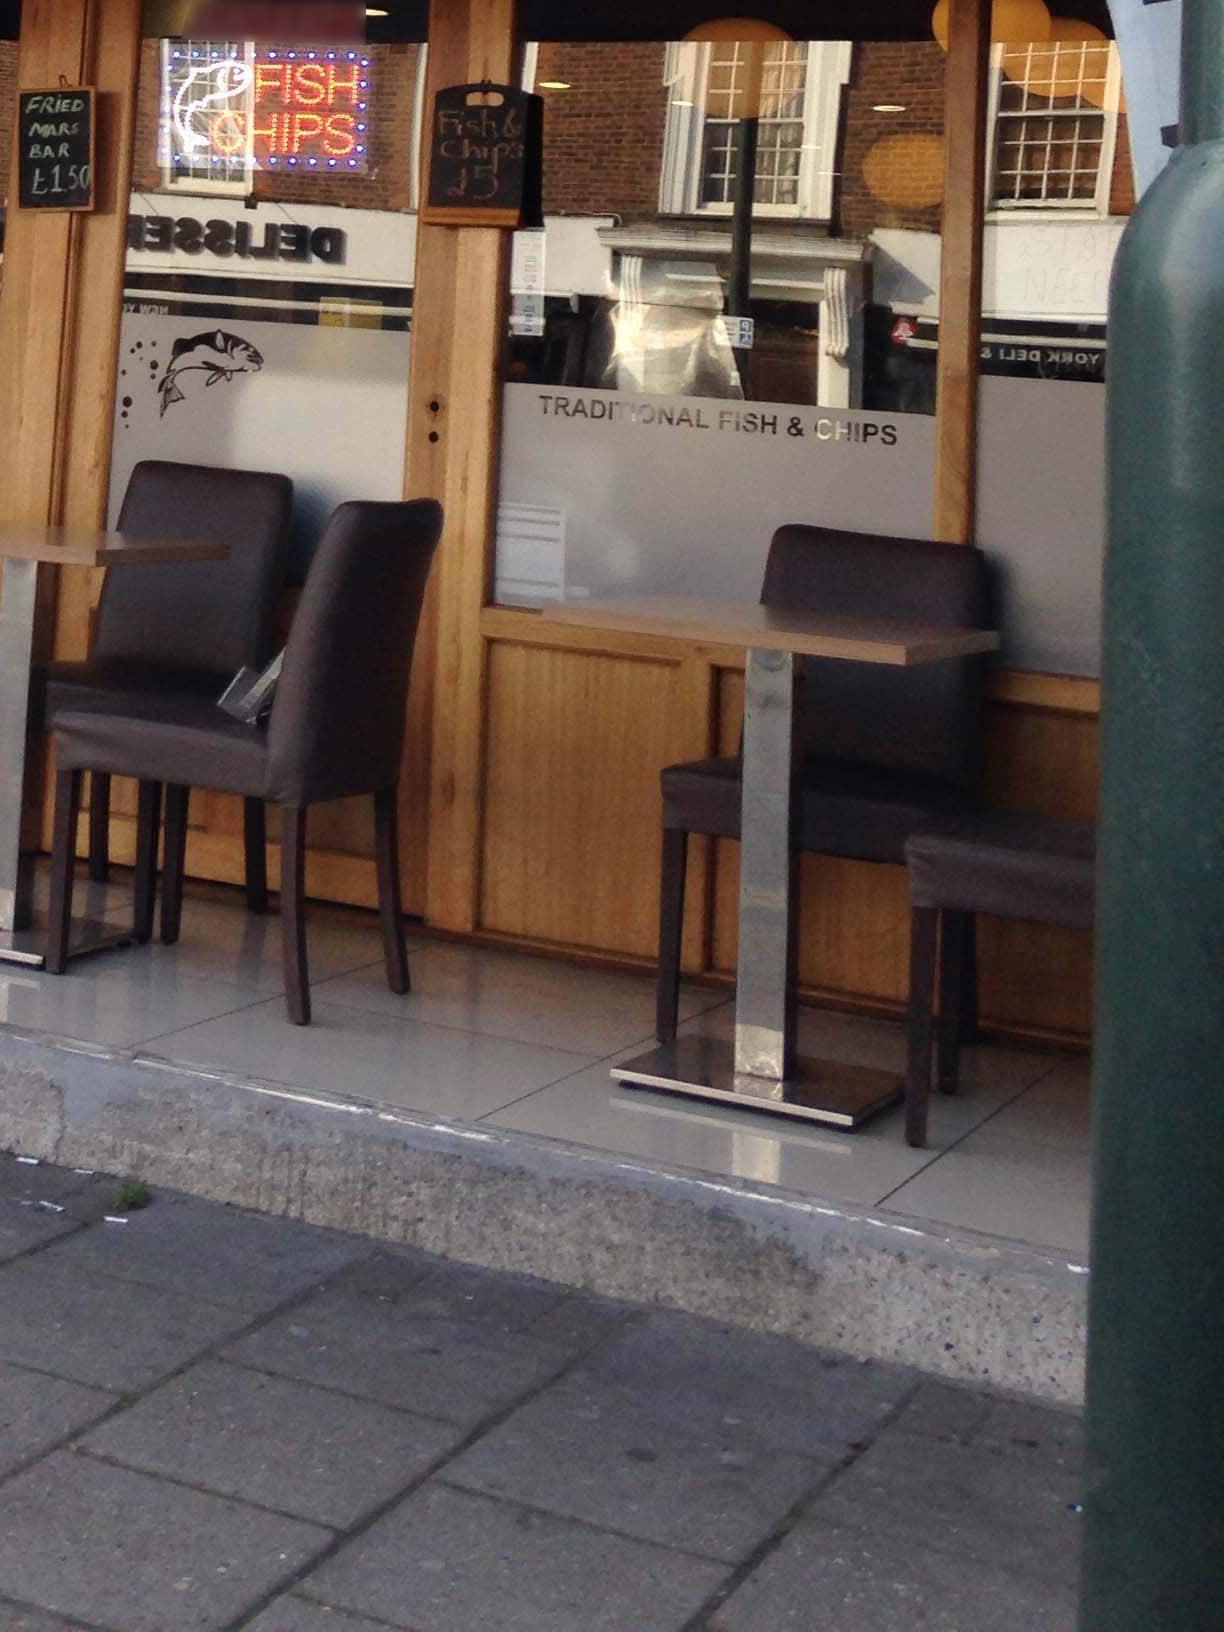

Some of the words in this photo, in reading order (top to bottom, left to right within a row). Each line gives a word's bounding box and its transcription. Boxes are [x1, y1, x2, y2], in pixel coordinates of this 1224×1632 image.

[254, 63, 361, 105] FISH
[25, 94, 85, 114] FRIED
[28, 121, 80, 138] MARS
[212, 112, 356, 156] CHIPS
[29, 142, 70, 158] BAR
[539, 395, 710, 431] TRADITIONAL
[719, 410, 778, 436] FISH
[787, 417, 805, 438] &
[815, 418, 898, 447] CHIPS
